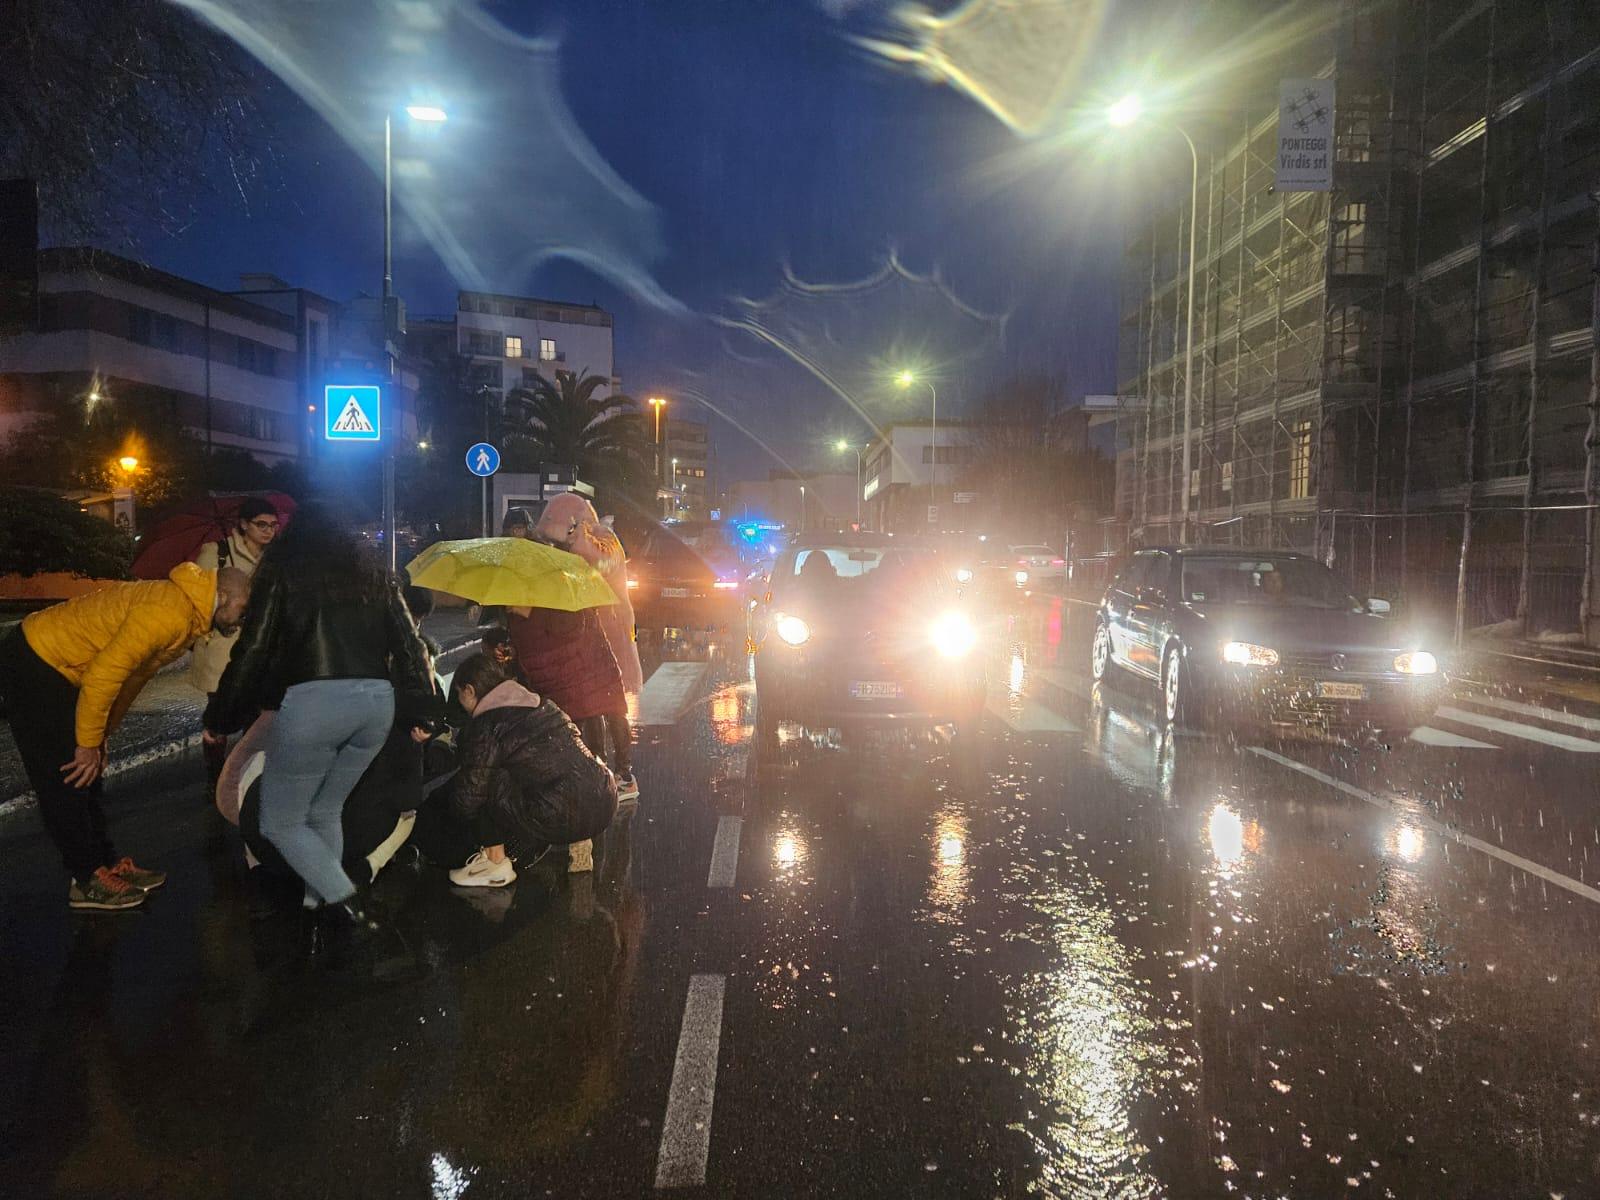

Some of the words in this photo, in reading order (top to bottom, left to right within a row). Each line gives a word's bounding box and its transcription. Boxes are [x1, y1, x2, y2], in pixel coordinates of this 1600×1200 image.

[1281, 137, 1327, 151] PONTEGGI
[1280, 153, 1310, 169] Virdis
[1313, 153, 1327, 169] srl
